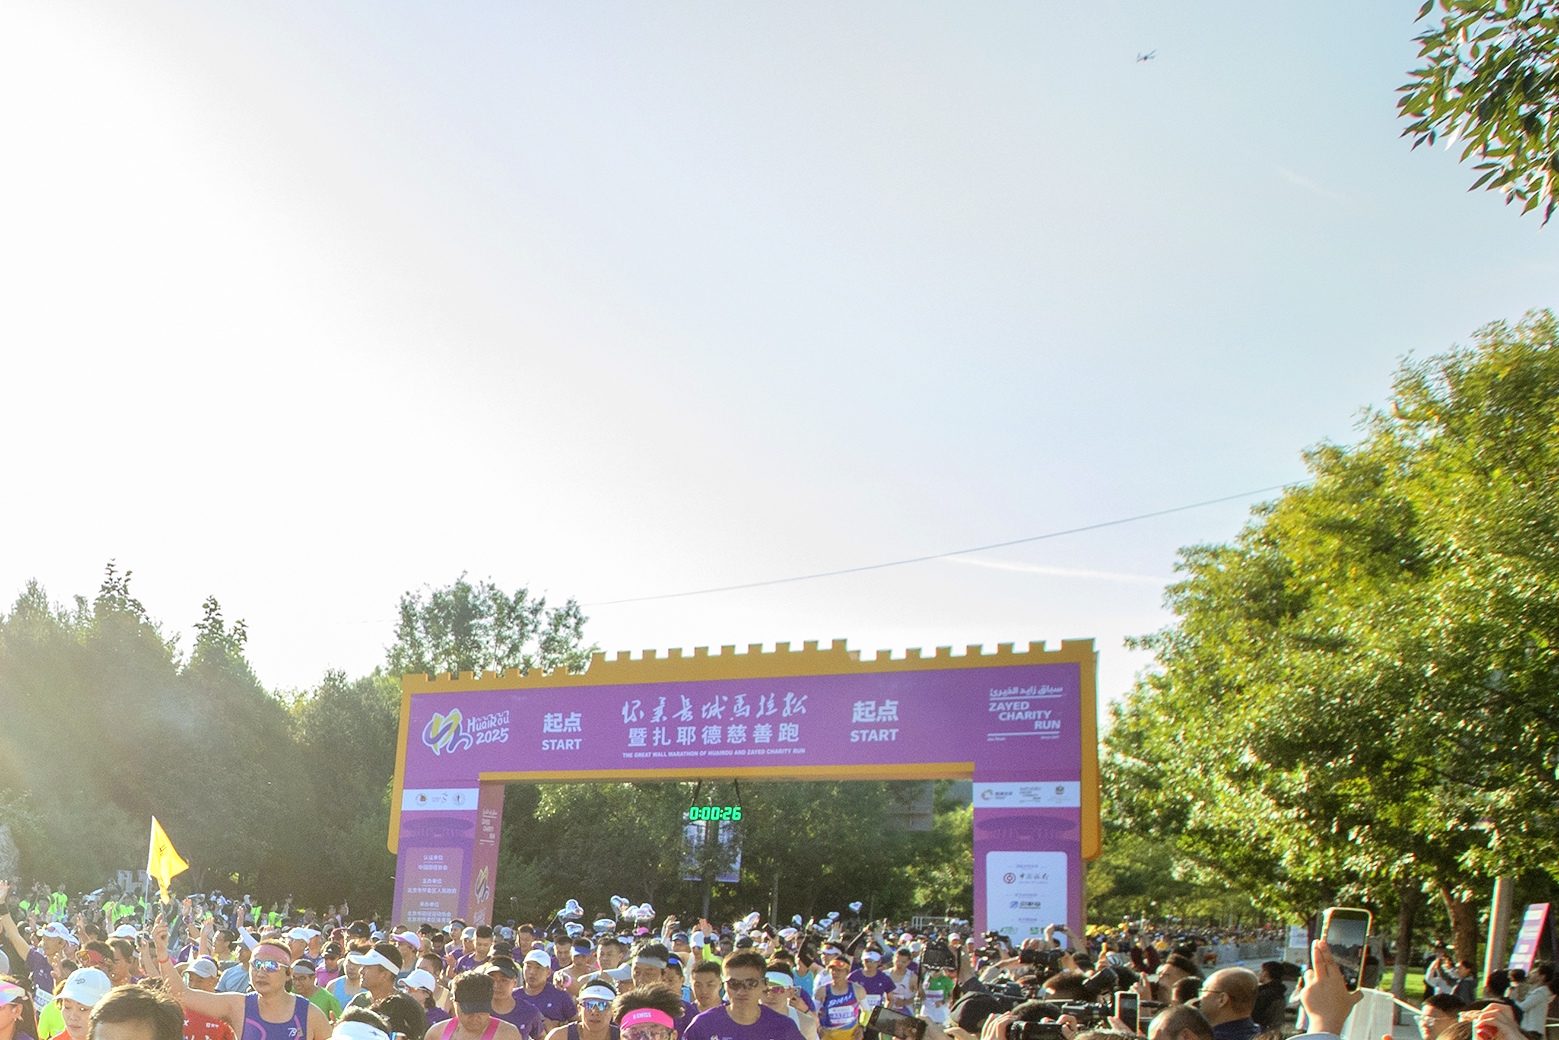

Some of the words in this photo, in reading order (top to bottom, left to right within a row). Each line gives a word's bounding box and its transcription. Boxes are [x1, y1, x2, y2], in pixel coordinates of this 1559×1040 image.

[851, 699, 899, 723] 起点
[988, 702, 1030, 712] ZAYED
[542, 711, 583, 734] 起点
[998, 710, 1052, 721] CHARITY
[1034, 719, 1061, 731] RUN
[475, 727, 511, 745] 2025
[627, 722, 800, 748] 暨扎耶德慈善跑
[850, 728, 899, 743] START
[542, 738, 581, 751] START
[689, 806, 742, 821] 0:00:26
